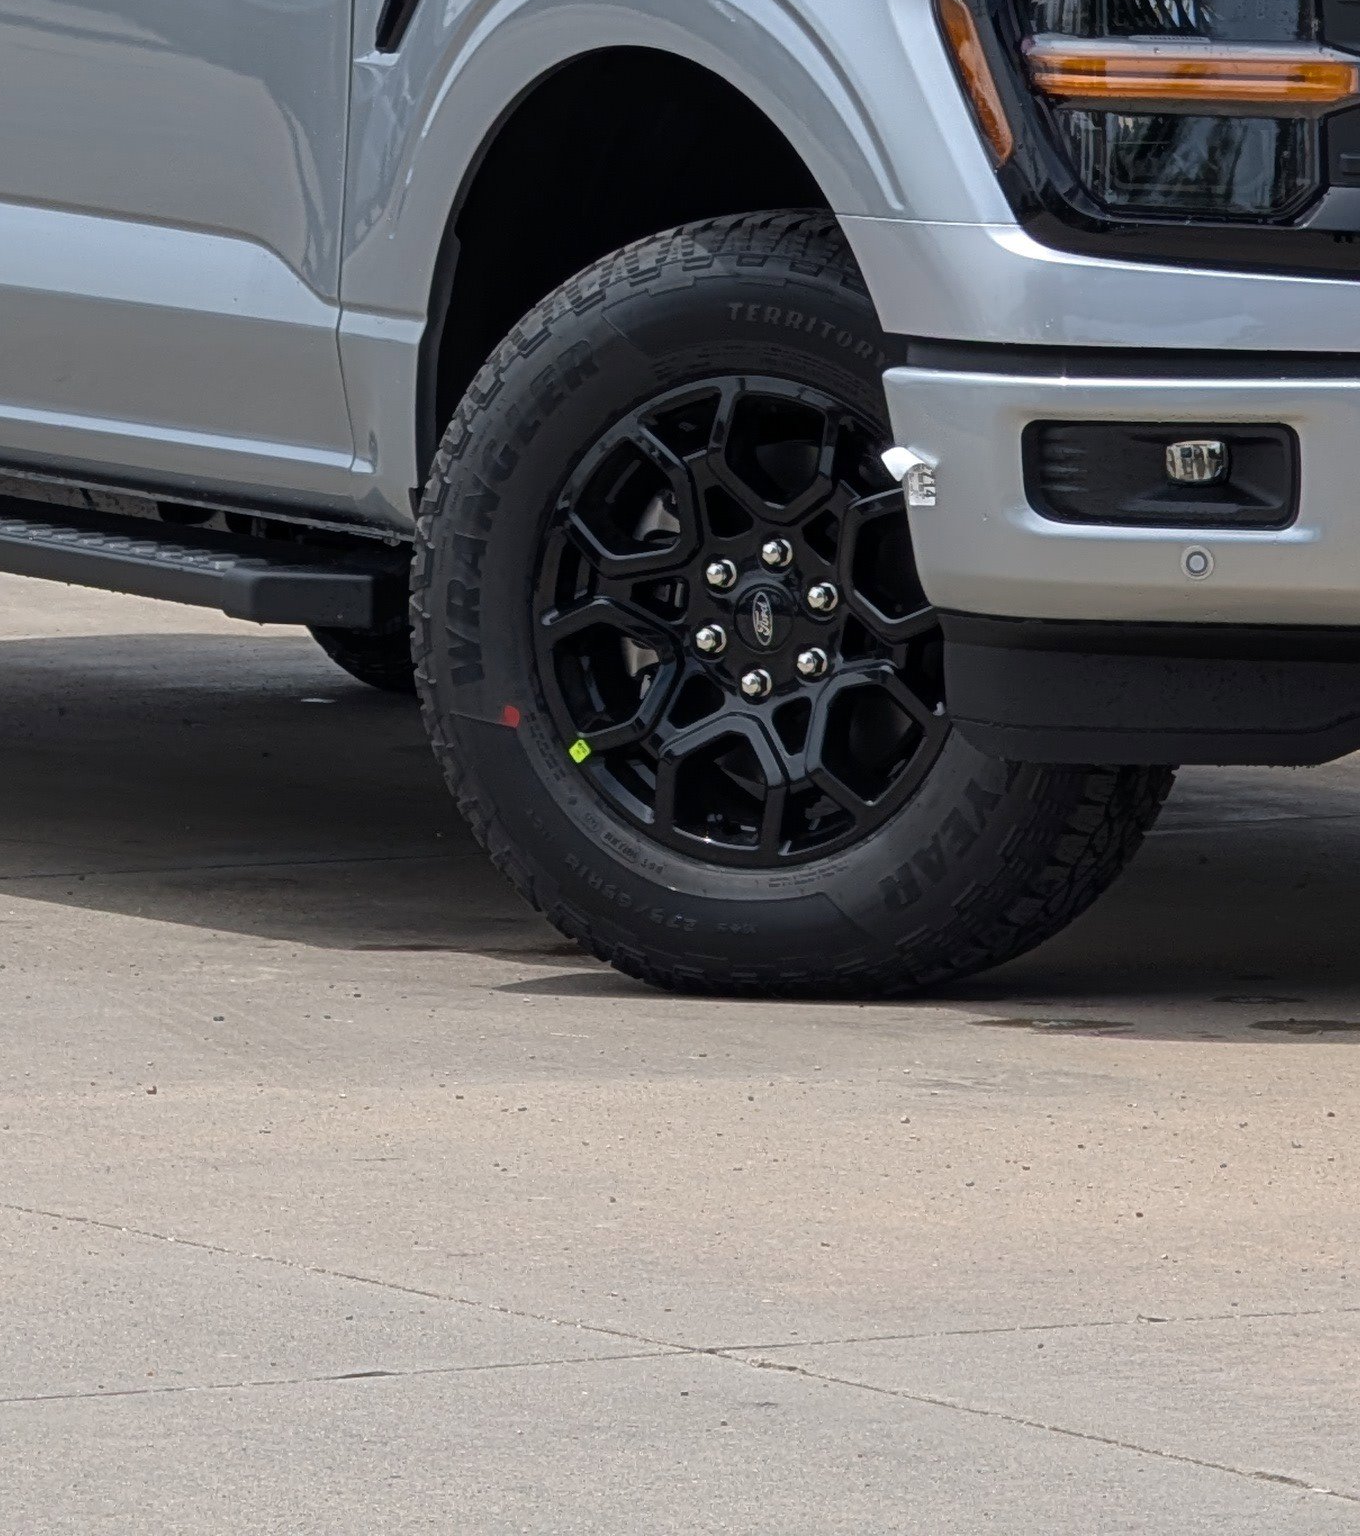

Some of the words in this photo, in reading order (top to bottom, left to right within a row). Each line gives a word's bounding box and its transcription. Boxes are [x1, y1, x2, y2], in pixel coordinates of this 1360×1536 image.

[728, 302, 887, 367] TERRITORY
[444, 338, 599, 686] WRANGLER
[754, 602, 770, 636] Ford
[878, 778, 1005, 905] YEAR
